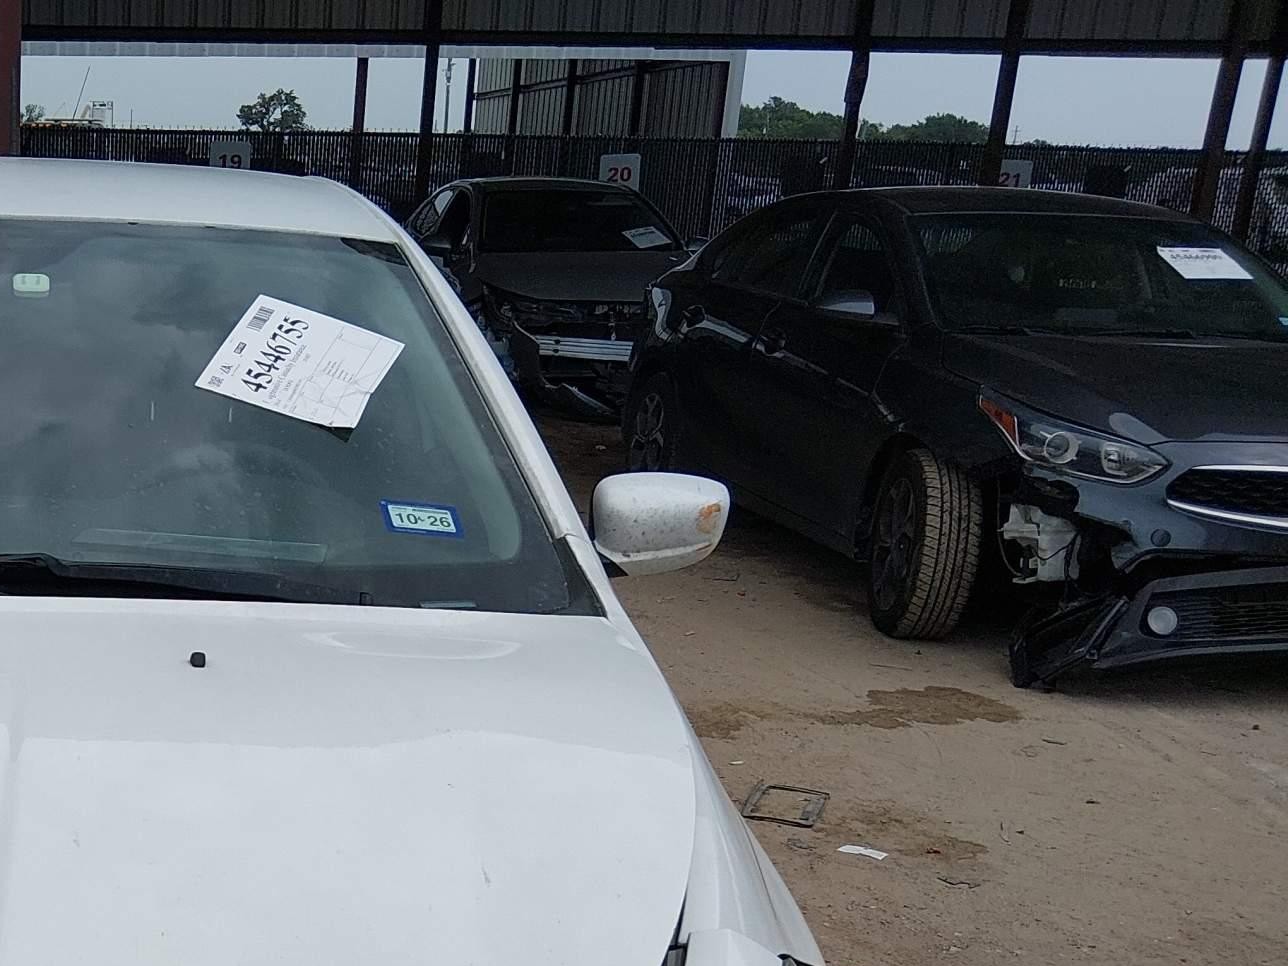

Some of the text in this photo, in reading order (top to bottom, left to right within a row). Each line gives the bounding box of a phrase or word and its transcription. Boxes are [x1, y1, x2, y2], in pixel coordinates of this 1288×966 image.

[219, 154, 242, 168] 19
[607, 167, 632, 182] 20
[1000, 172, 1020, 187] 21
[240, 316, 309, 393] 45446755
